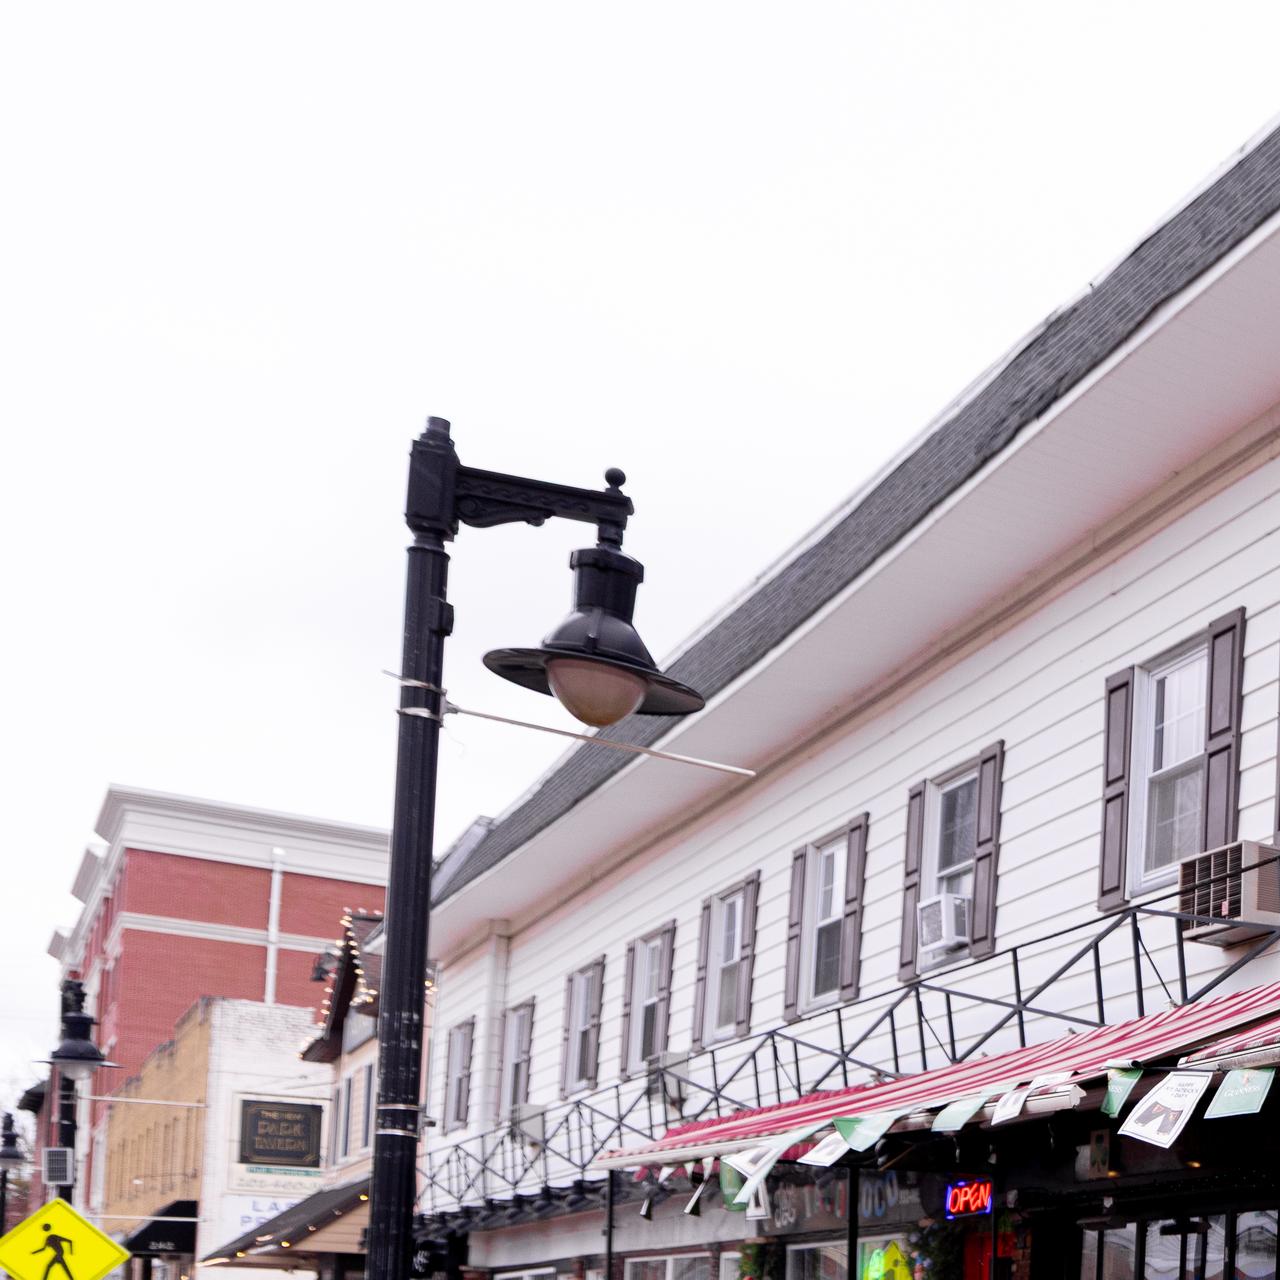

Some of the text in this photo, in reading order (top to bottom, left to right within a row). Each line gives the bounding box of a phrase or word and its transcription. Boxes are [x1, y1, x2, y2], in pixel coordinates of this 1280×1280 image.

[257, 1121, 305, 1137] PARK
[255, 1136, 305, 1151] TAVERN
[948, 1181, 992, 1214] OPEN
